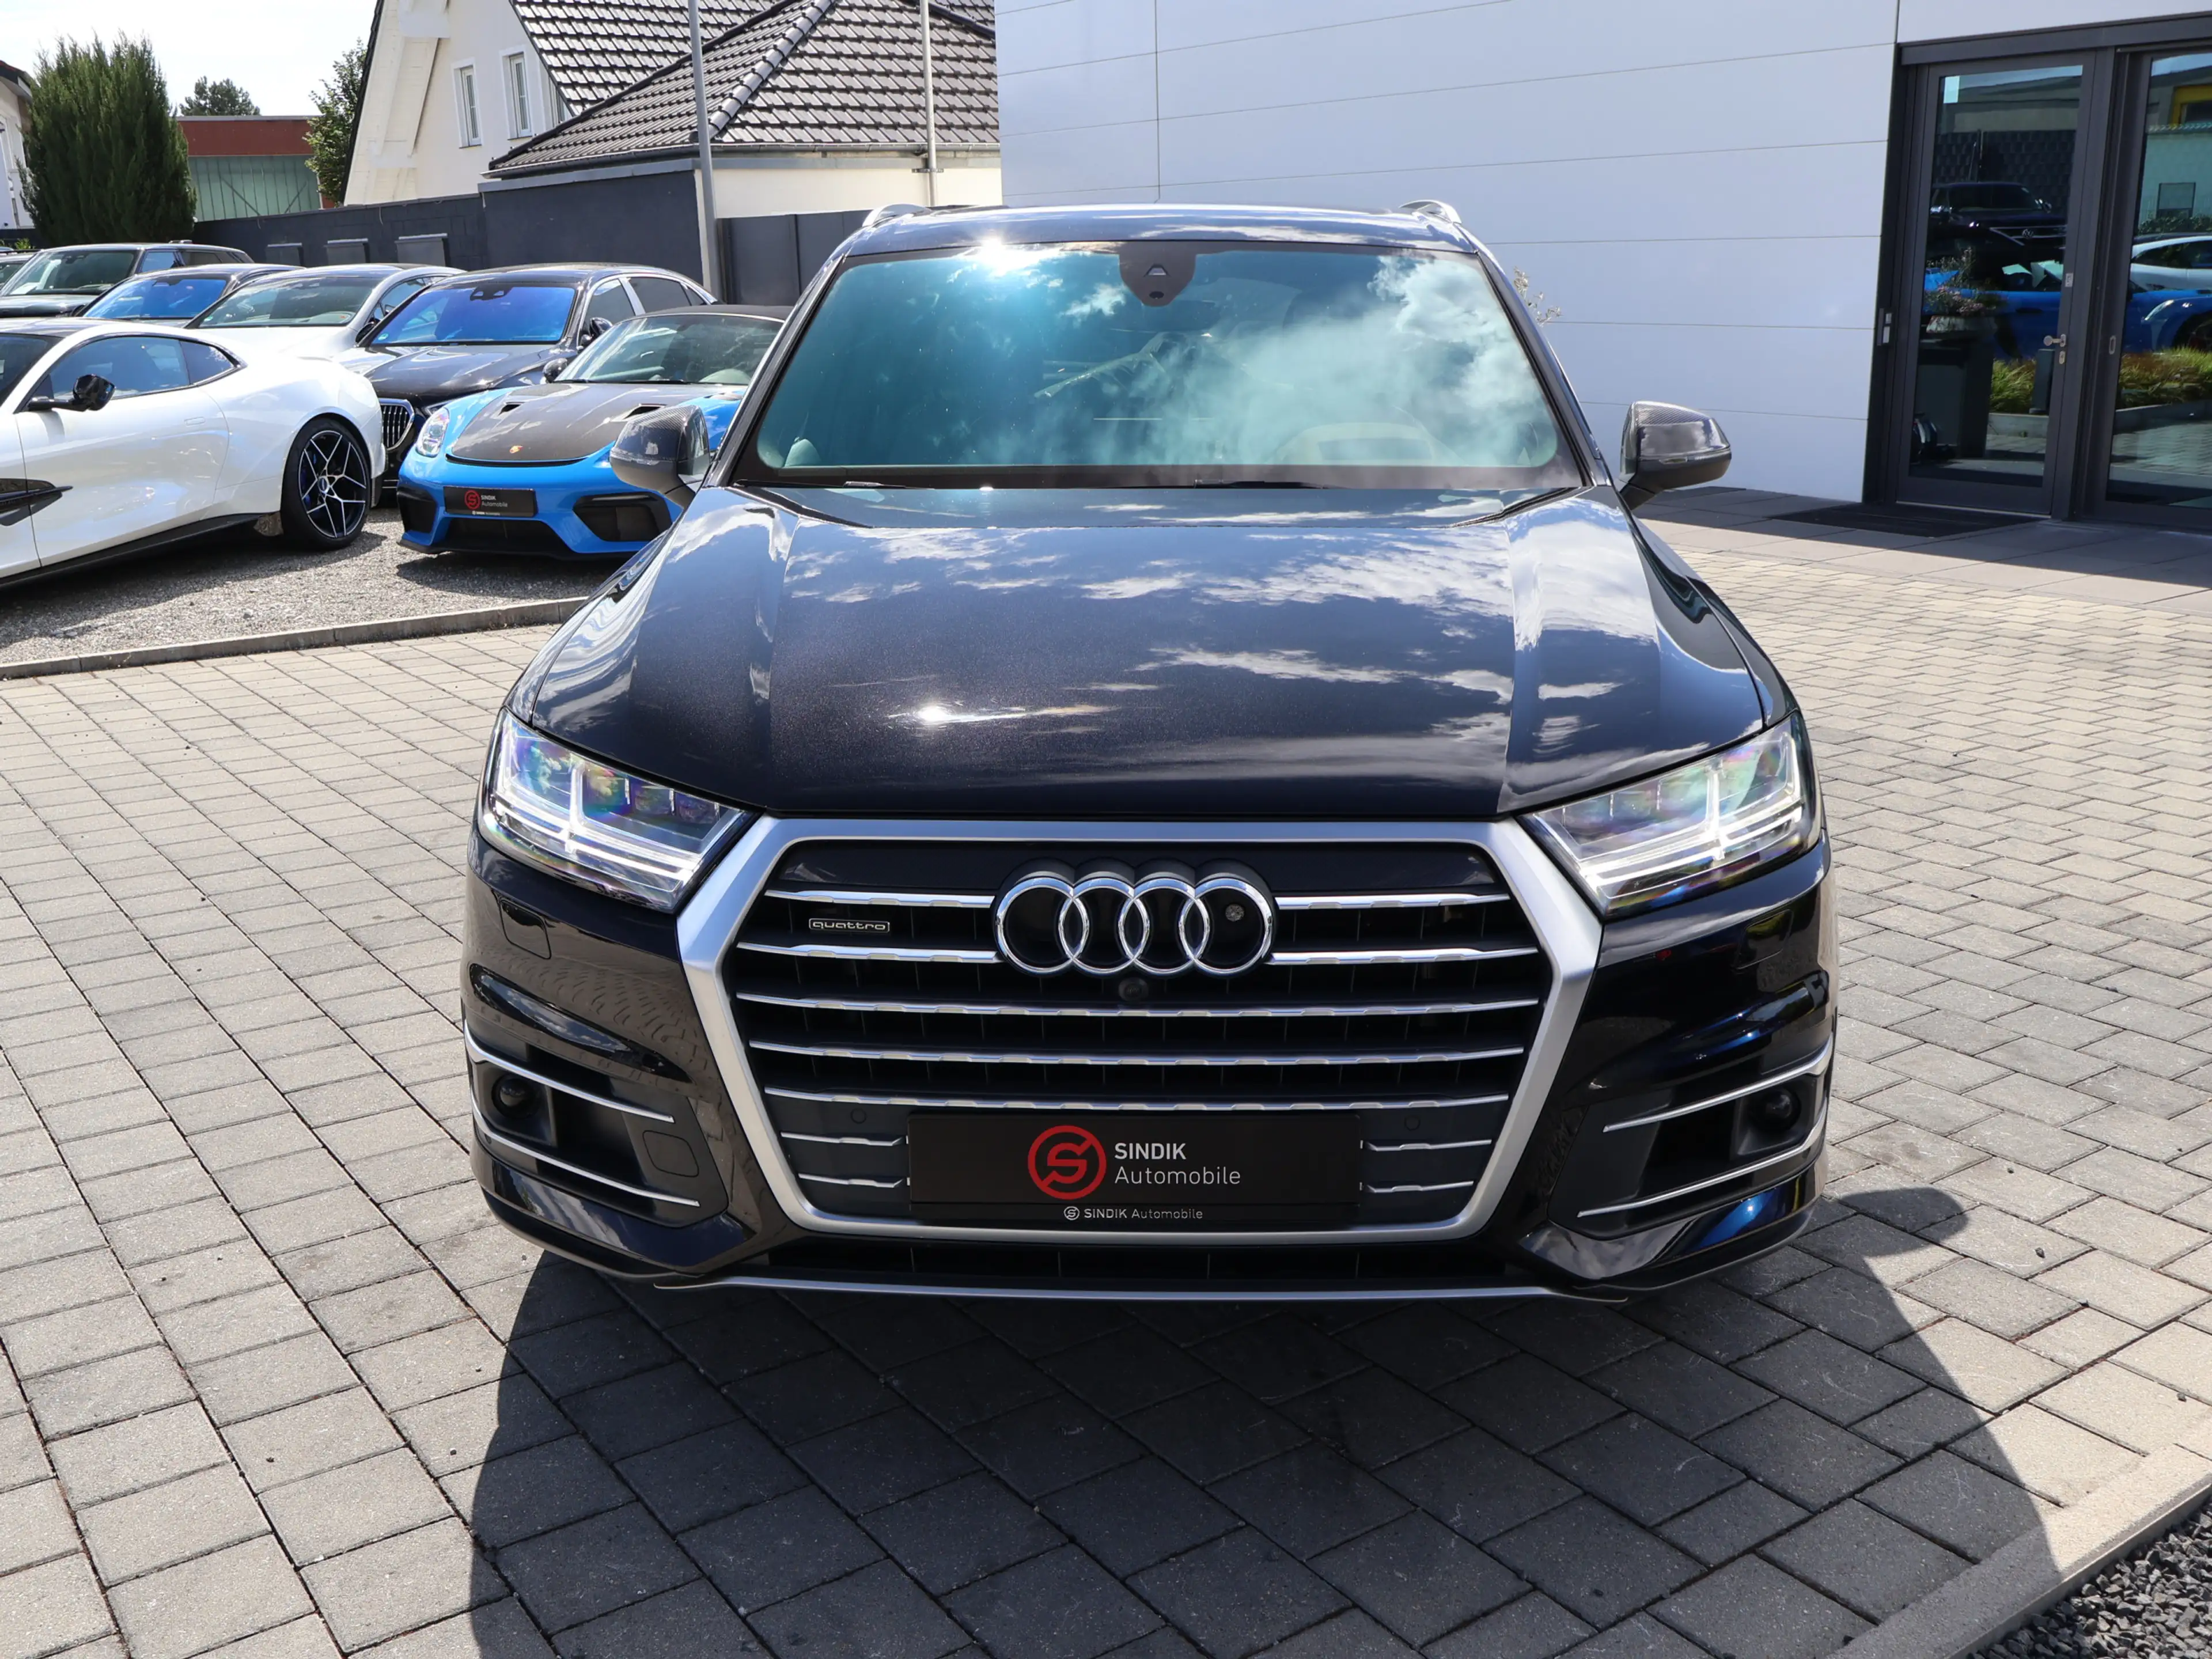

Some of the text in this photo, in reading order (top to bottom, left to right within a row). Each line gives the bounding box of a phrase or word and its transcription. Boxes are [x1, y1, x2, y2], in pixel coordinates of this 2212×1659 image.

[812, 921, 886, 930] quattro
[1114, 1142, 1187, 1160] SINDIK
[1114, 1166, 1241, 1185] Automobile
[1084, 1208, 1127, 1219] SINDIK
[1131, 1208, 1203, 1219] Automobile
